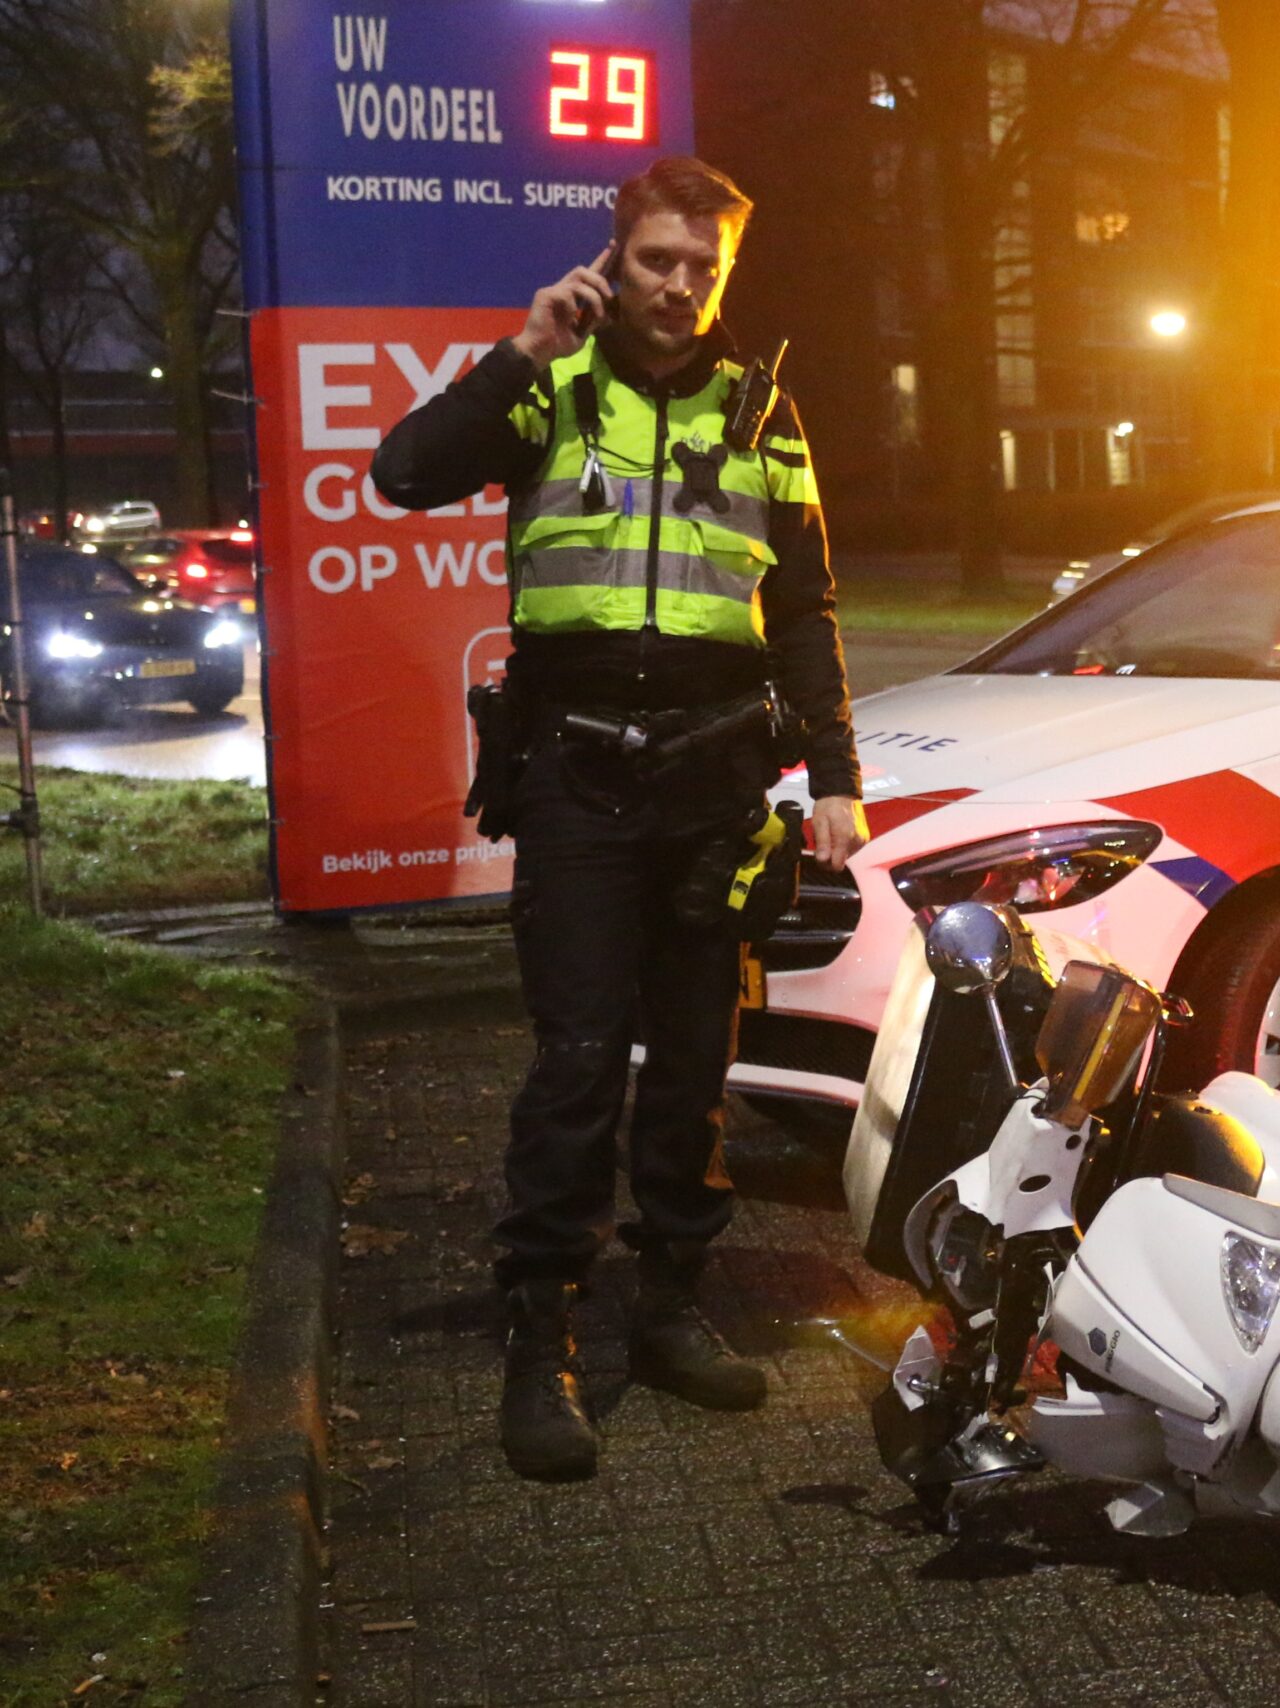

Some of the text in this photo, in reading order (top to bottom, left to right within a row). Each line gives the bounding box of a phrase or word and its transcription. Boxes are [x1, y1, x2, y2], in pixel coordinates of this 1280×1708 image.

[333, 16, 387, 72] UW
[336, 82, 503, 144] VOORDEEL
[550, 51, 646, 140] 29
[327, 176, 442, 203] KORTING
[454, 179, 513, 204] INCL.
[298, 343, 497, 450] EX
[308, 546, 398, 594] OP
[855, 731, 958, 752] ITIE
[322, 849, 393, 874] Bekijk
[398, 849, 449, 867] onze
